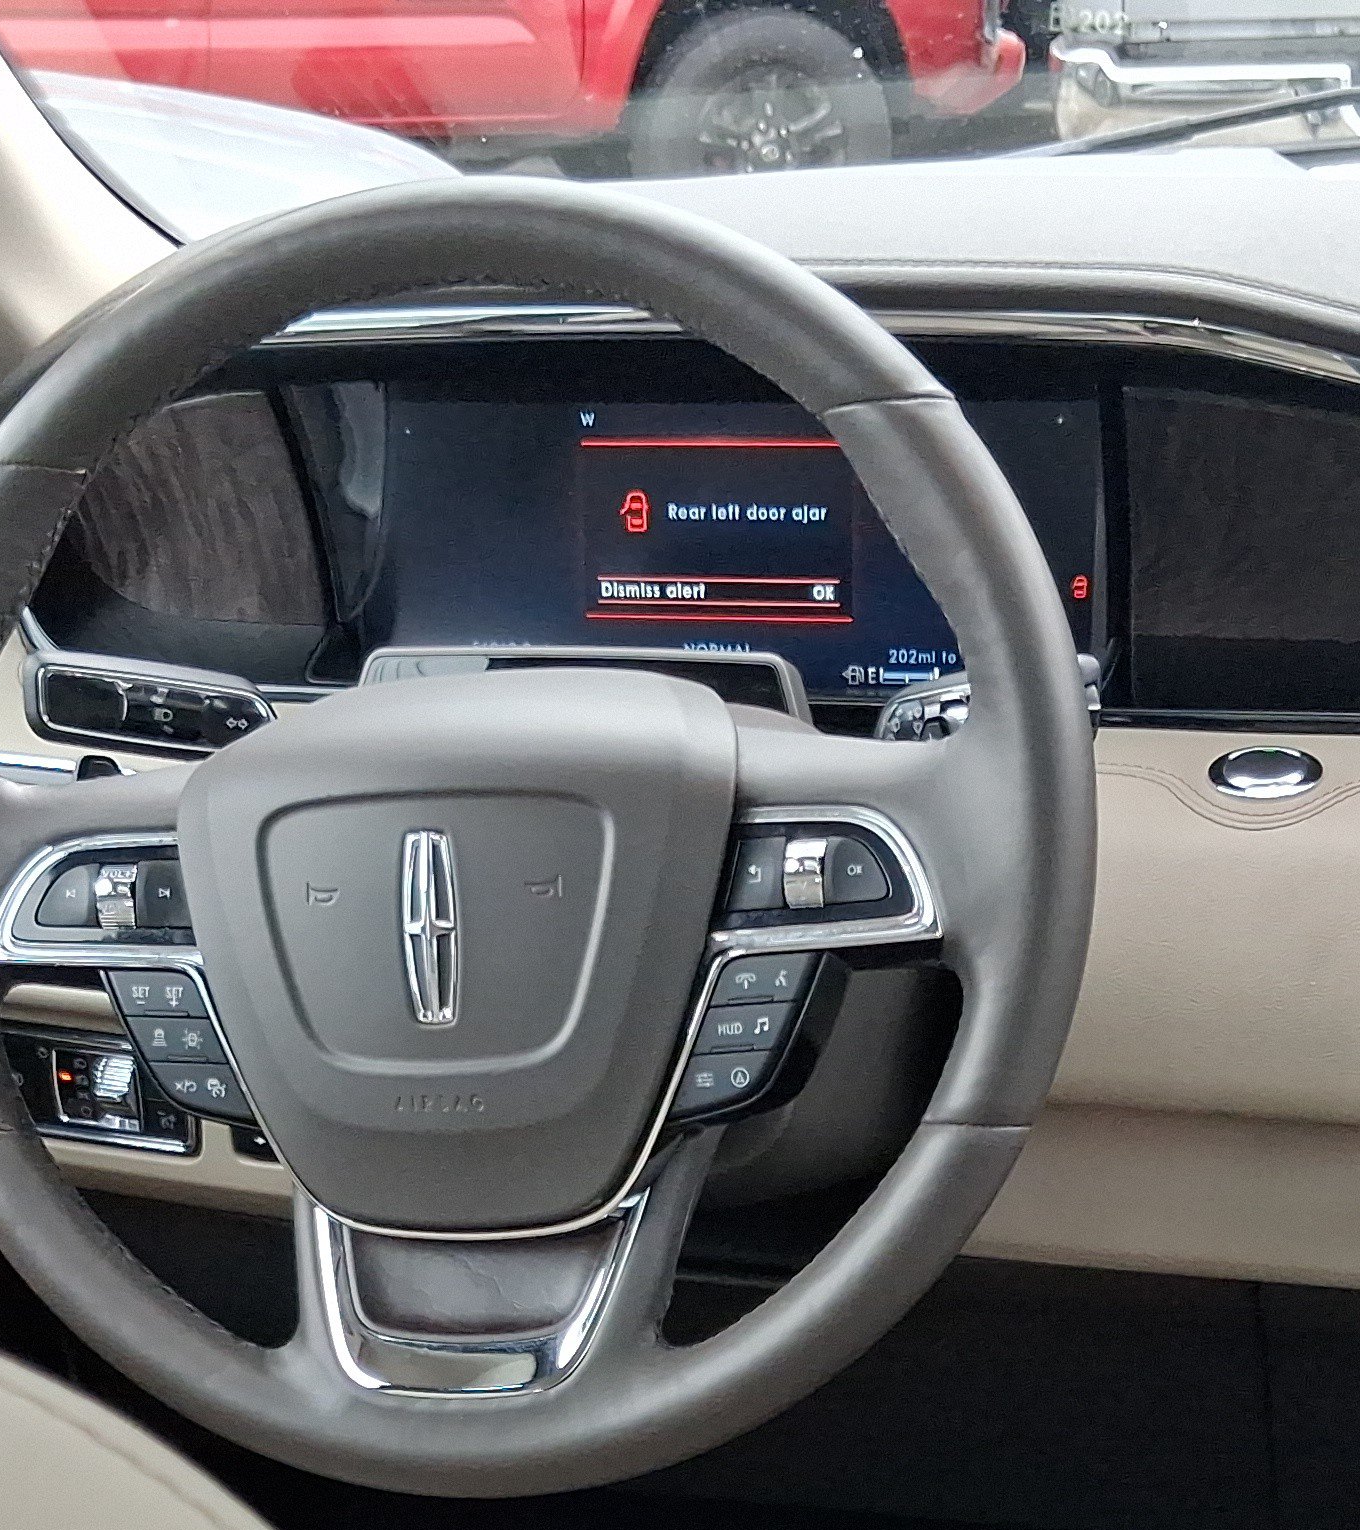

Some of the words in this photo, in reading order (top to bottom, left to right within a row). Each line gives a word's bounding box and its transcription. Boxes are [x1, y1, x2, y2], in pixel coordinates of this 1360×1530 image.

[579, 411, 595, 427] W
[667, 503, 706, 520] Rear
[711, 503, 740, 520] left
[746, 503, 786, 521] door
[792, 505, 828, 523] ajar
[601, 582, 660, 598] Dismiss
[666, 582, 706, 599] alert
[813, 585, 835, 601] OK
[717, 1022, 743, 1035] HUD
